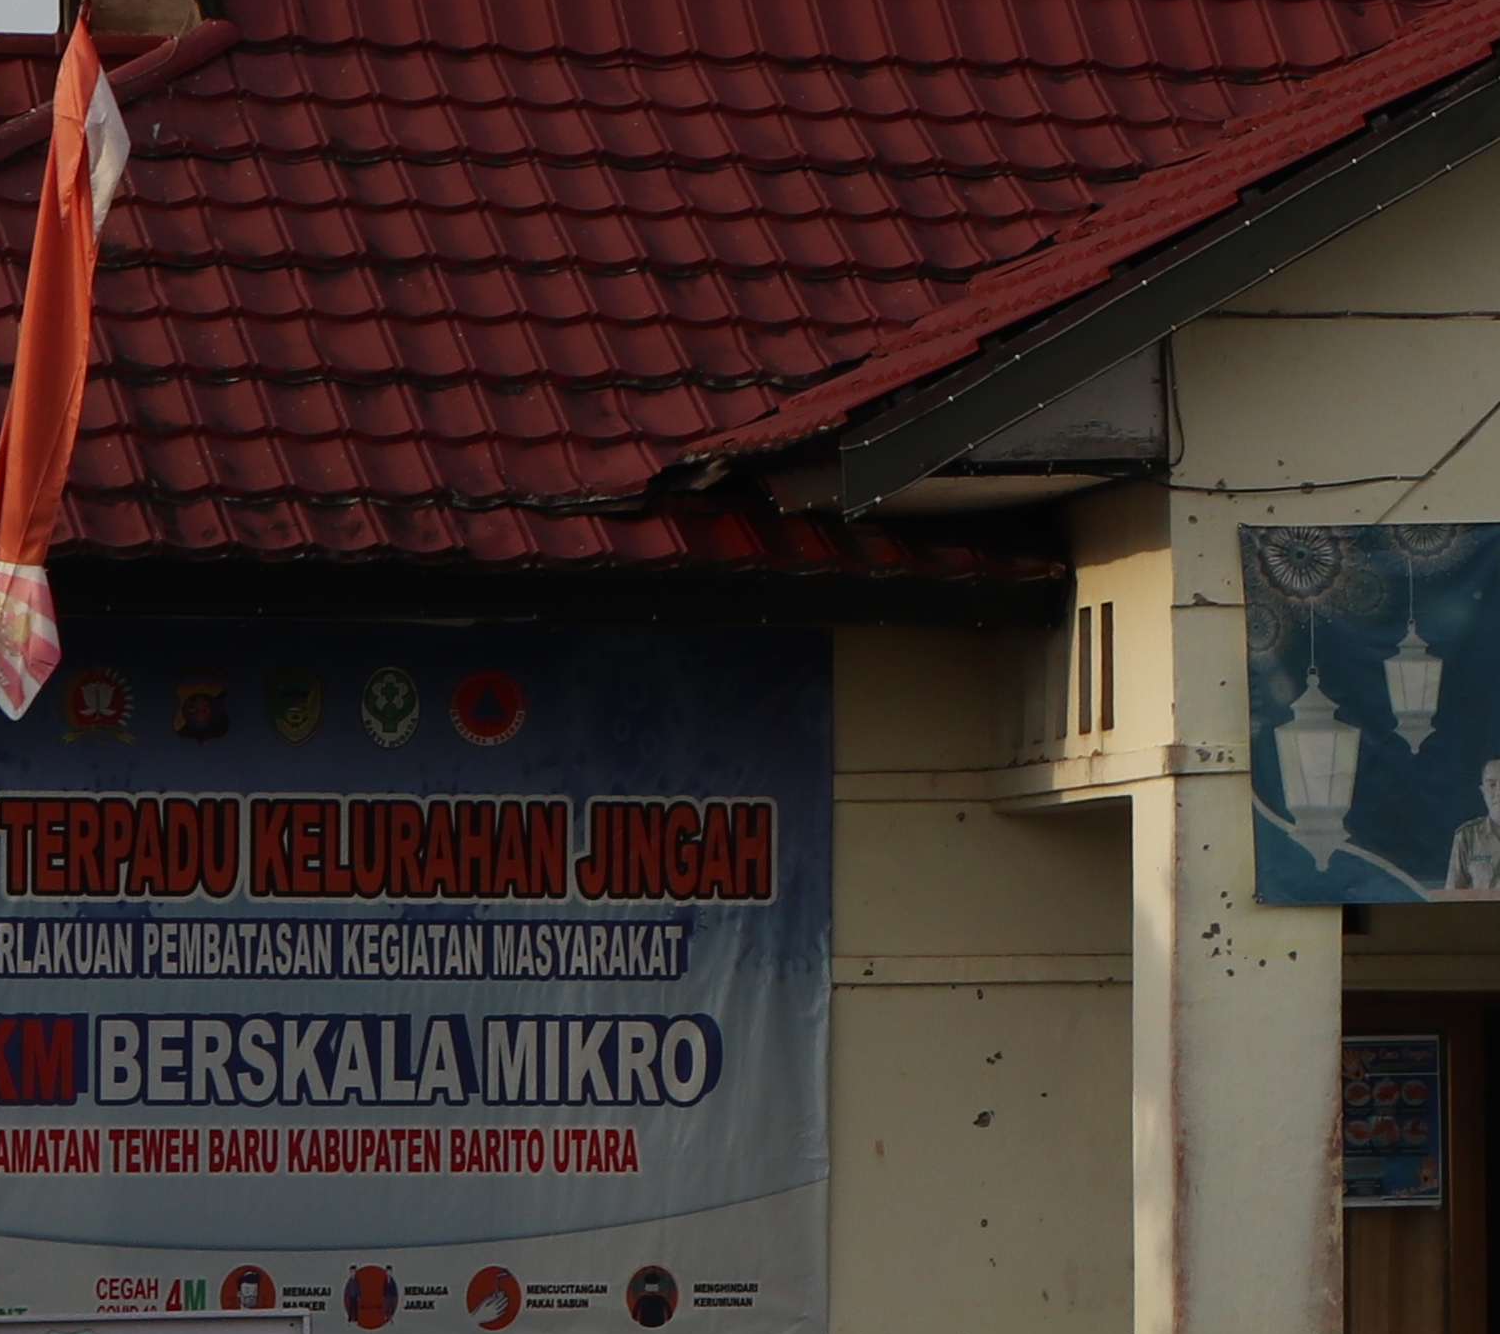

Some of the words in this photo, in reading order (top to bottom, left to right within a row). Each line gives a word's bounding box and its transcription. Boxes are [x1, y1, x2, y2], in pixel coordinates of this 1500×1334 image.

[250, 798, 569, 898] KELURAHAN
[576, 801, 772, 900] JINGAH
[142, 923, 333, 975] PEMBATASAN
[342, 924, 483, 976] KEGIATAN
[492, 925, 684, 977] MASYARAKAT
[97, 1017, 466, 1103] BERSKALA
[486, 1018, 709, 1104] MIKRO
[109, 1129, 199, 1173] TEWEH
[209, 1129, 279, 1174] BARU
[288, 1128, 441, 1173] KABUPATEN
[450, 1128, 545, 1174] BARITO
[554, 1128, 639, 1173] UTARA
[96, 1277, 158, 1300] CEGAH
[283, 1286, 331, 1297] MEMAKAI
[404, 1285, 449, 1296] MENJAGA
[693, 1282, 759, 1293] MENGHINDARI
[165, 1278, 206, 1311] 4M
[283, 1301, 326, 1312] MASKER
[403, 1300, 436, 1310] JARAK
[526, 1299, 554, 1309] PAKAI
[556, 1298, 589, 1309] SABUN
[693, 1297, 753, 1308] KERUMUNAN
